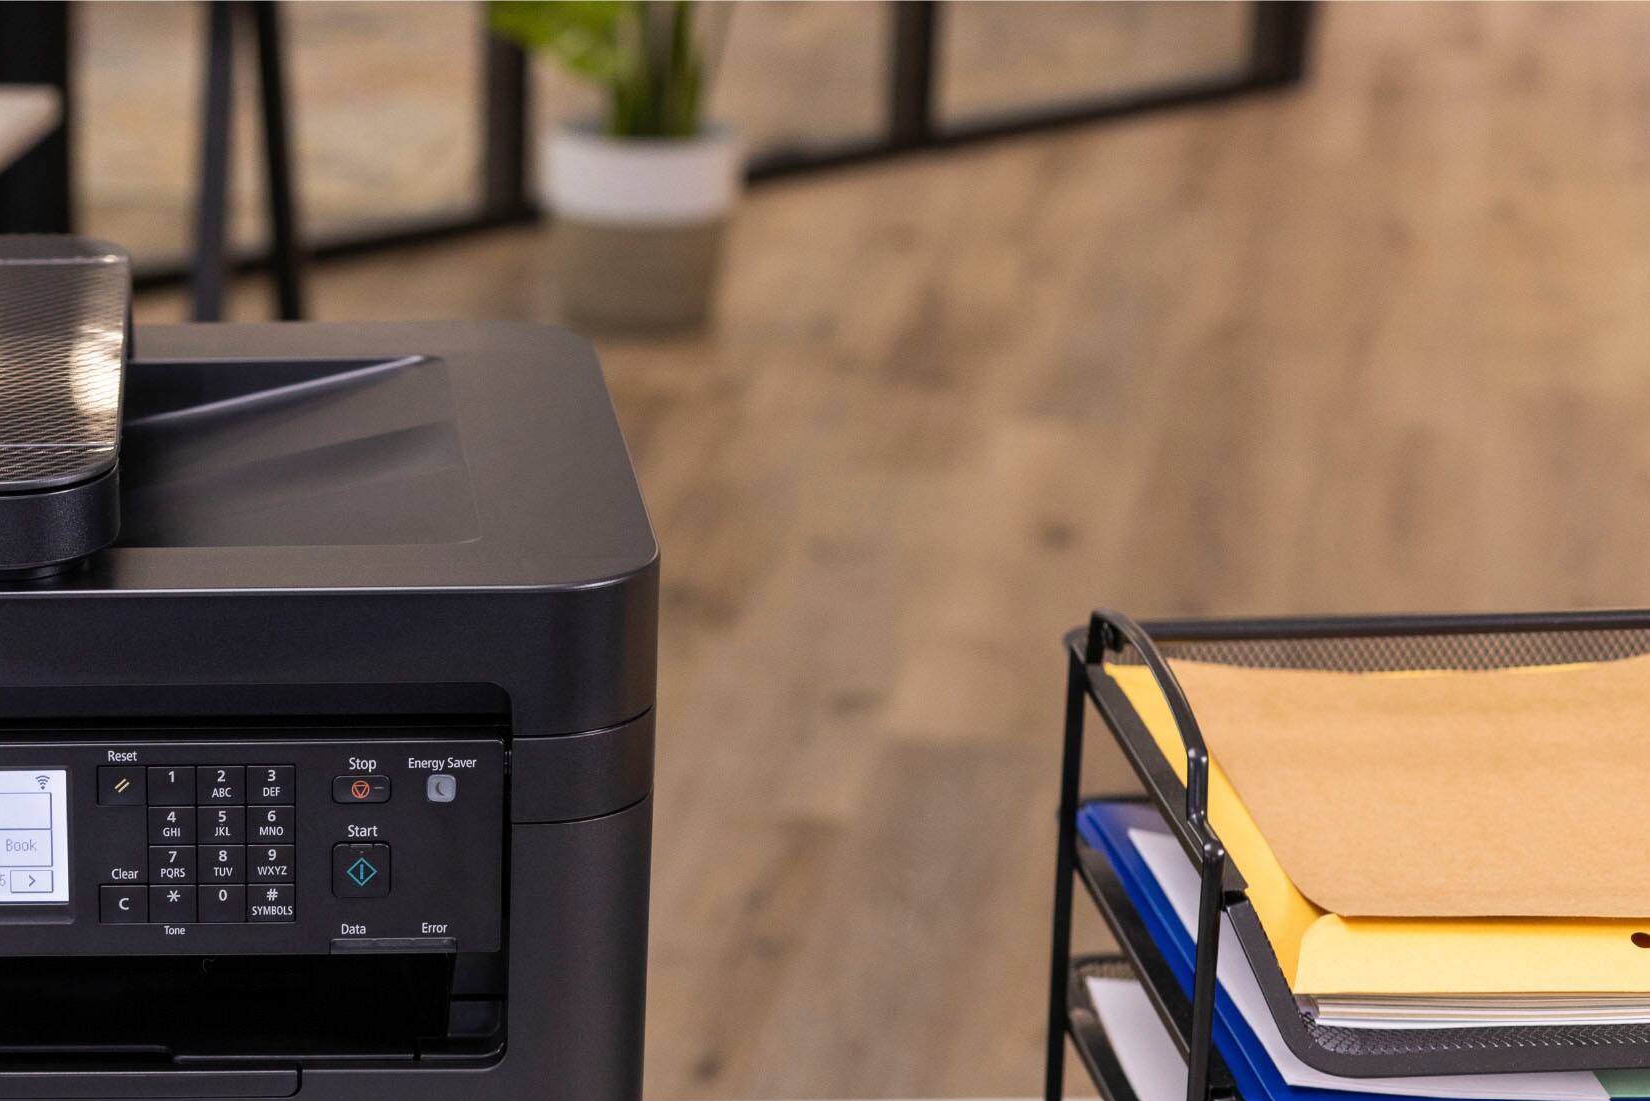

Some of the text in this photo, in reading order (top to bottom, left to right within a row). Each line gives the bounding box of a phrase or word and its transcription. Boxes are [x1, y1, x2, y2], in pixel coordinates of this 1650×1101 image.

[107, 750, 138, 762] Reset
[348, 756, 377, 773] Stop
[408, 756, 477, 771] Energy Saver
[168, 770, 175, 783] 1
[217, 769, 226, 783] 2
[267, 769, 276, 782] 3
[211, 787, 232, 799] ABC
[262, 786, 281, 797] DEF
[166, 811, 177, 823] 4
[218, 810, 227, 823] 5
[267, 810, 277, 822] 6
[162, 827, 181, 837] GHI
[214, 826, 231, 837] JKL
[259, 826, 284, 836] MNO
[347, 824, 378, 838] Start
[5, 838, 37, 852] Book
[168, 850, 178, 863] 7
[218, 849, 228, 862] 8
[267, 848, 277, 861] 9
[111, 867, 139, 880] Clear
[160, 867, 186, 879] PQRS
[213, 866, 233, 877] TUV
[257, 865, 288, 876] WXYZ
[218, 889, 228, 902] 0
[118, 897, 130, 911] C
[252, 905, 293, 916] SYMBOLS
[163, 925, 186, 936] Tone
[341, 923, 367, 935] Data
[421, 922, 448, 934] Error
